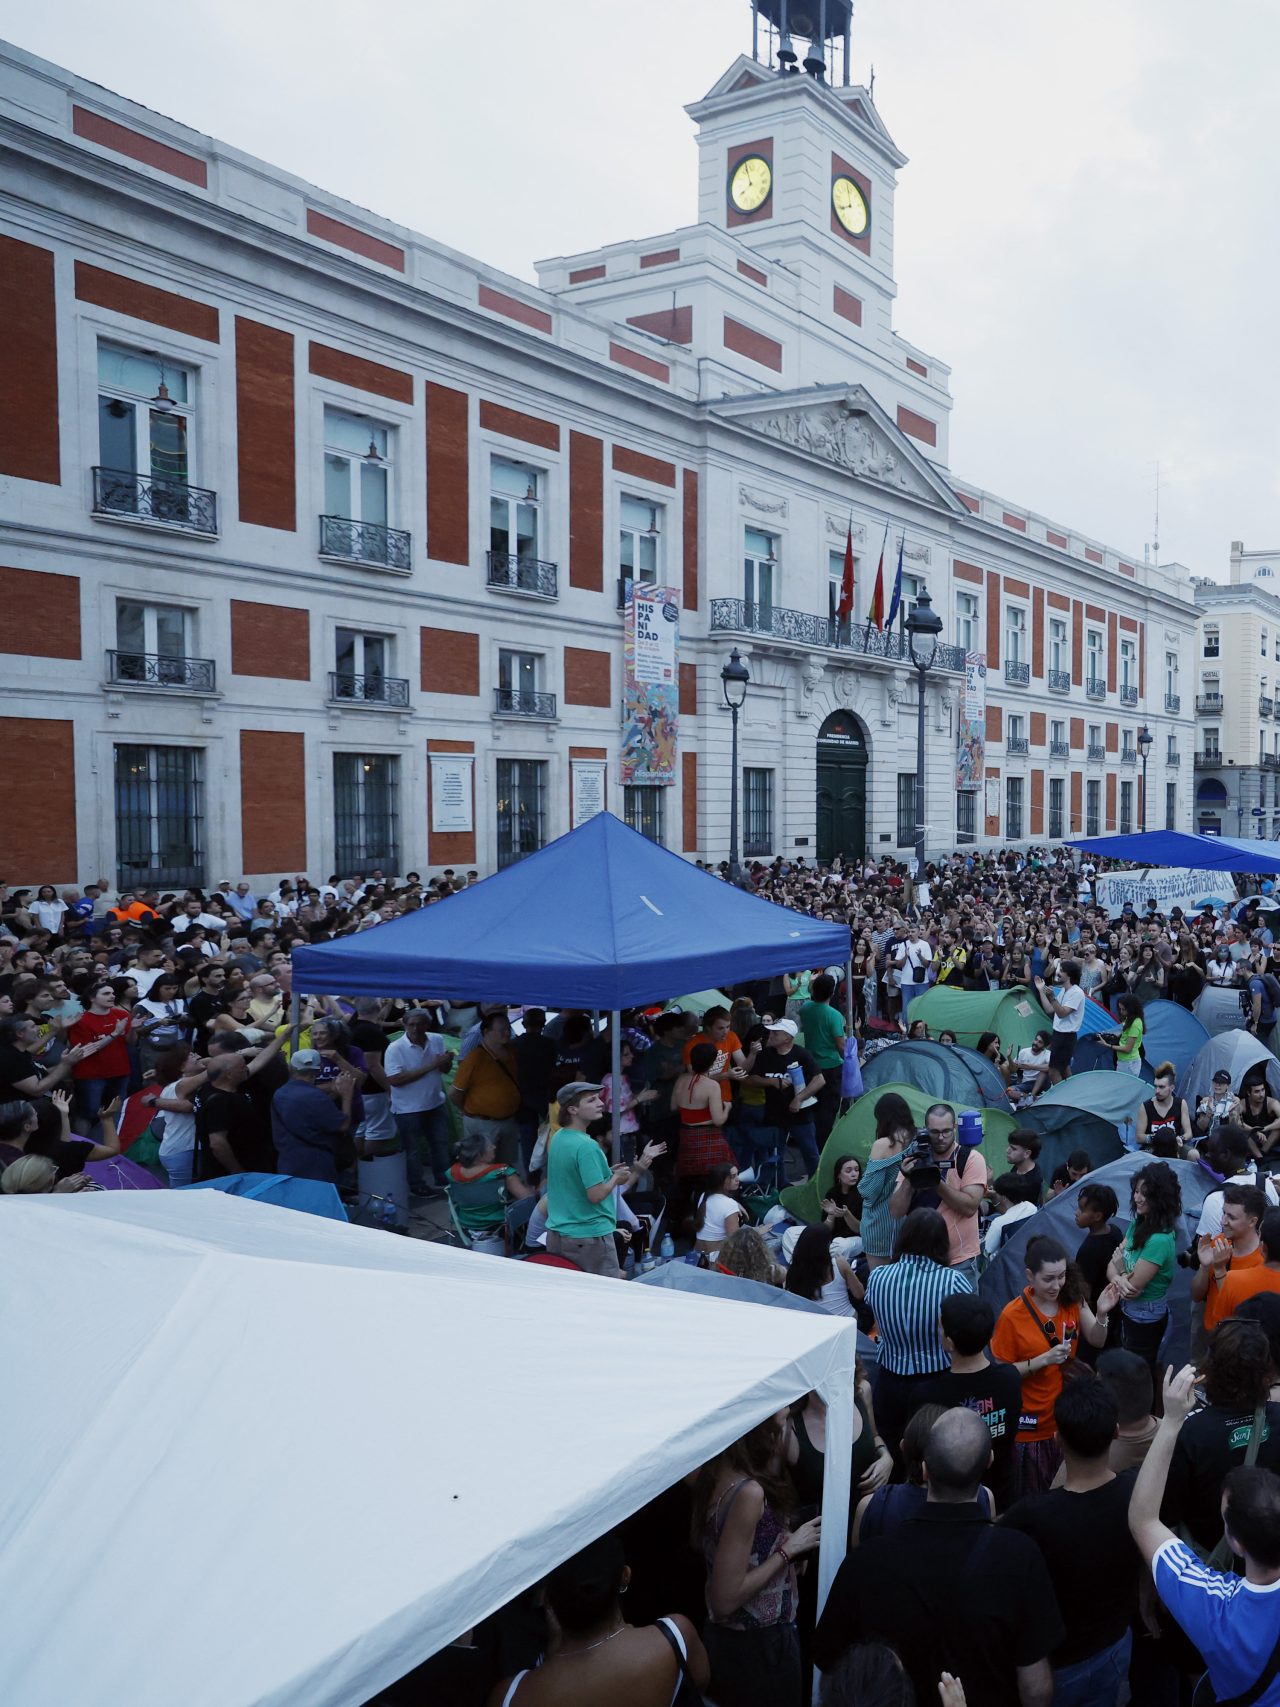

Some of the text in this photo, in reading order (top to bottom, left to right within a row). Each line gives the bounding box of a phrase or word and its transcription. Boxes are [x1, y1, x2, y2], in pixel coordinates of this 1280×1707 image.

[637, 602, 654, 614] HIS
[637, 611, 651, 622] PA
[637, 621, 648, 632] NI
[637, 630, 659, 642] DAD
[966, 684, 977, 692] DAD
